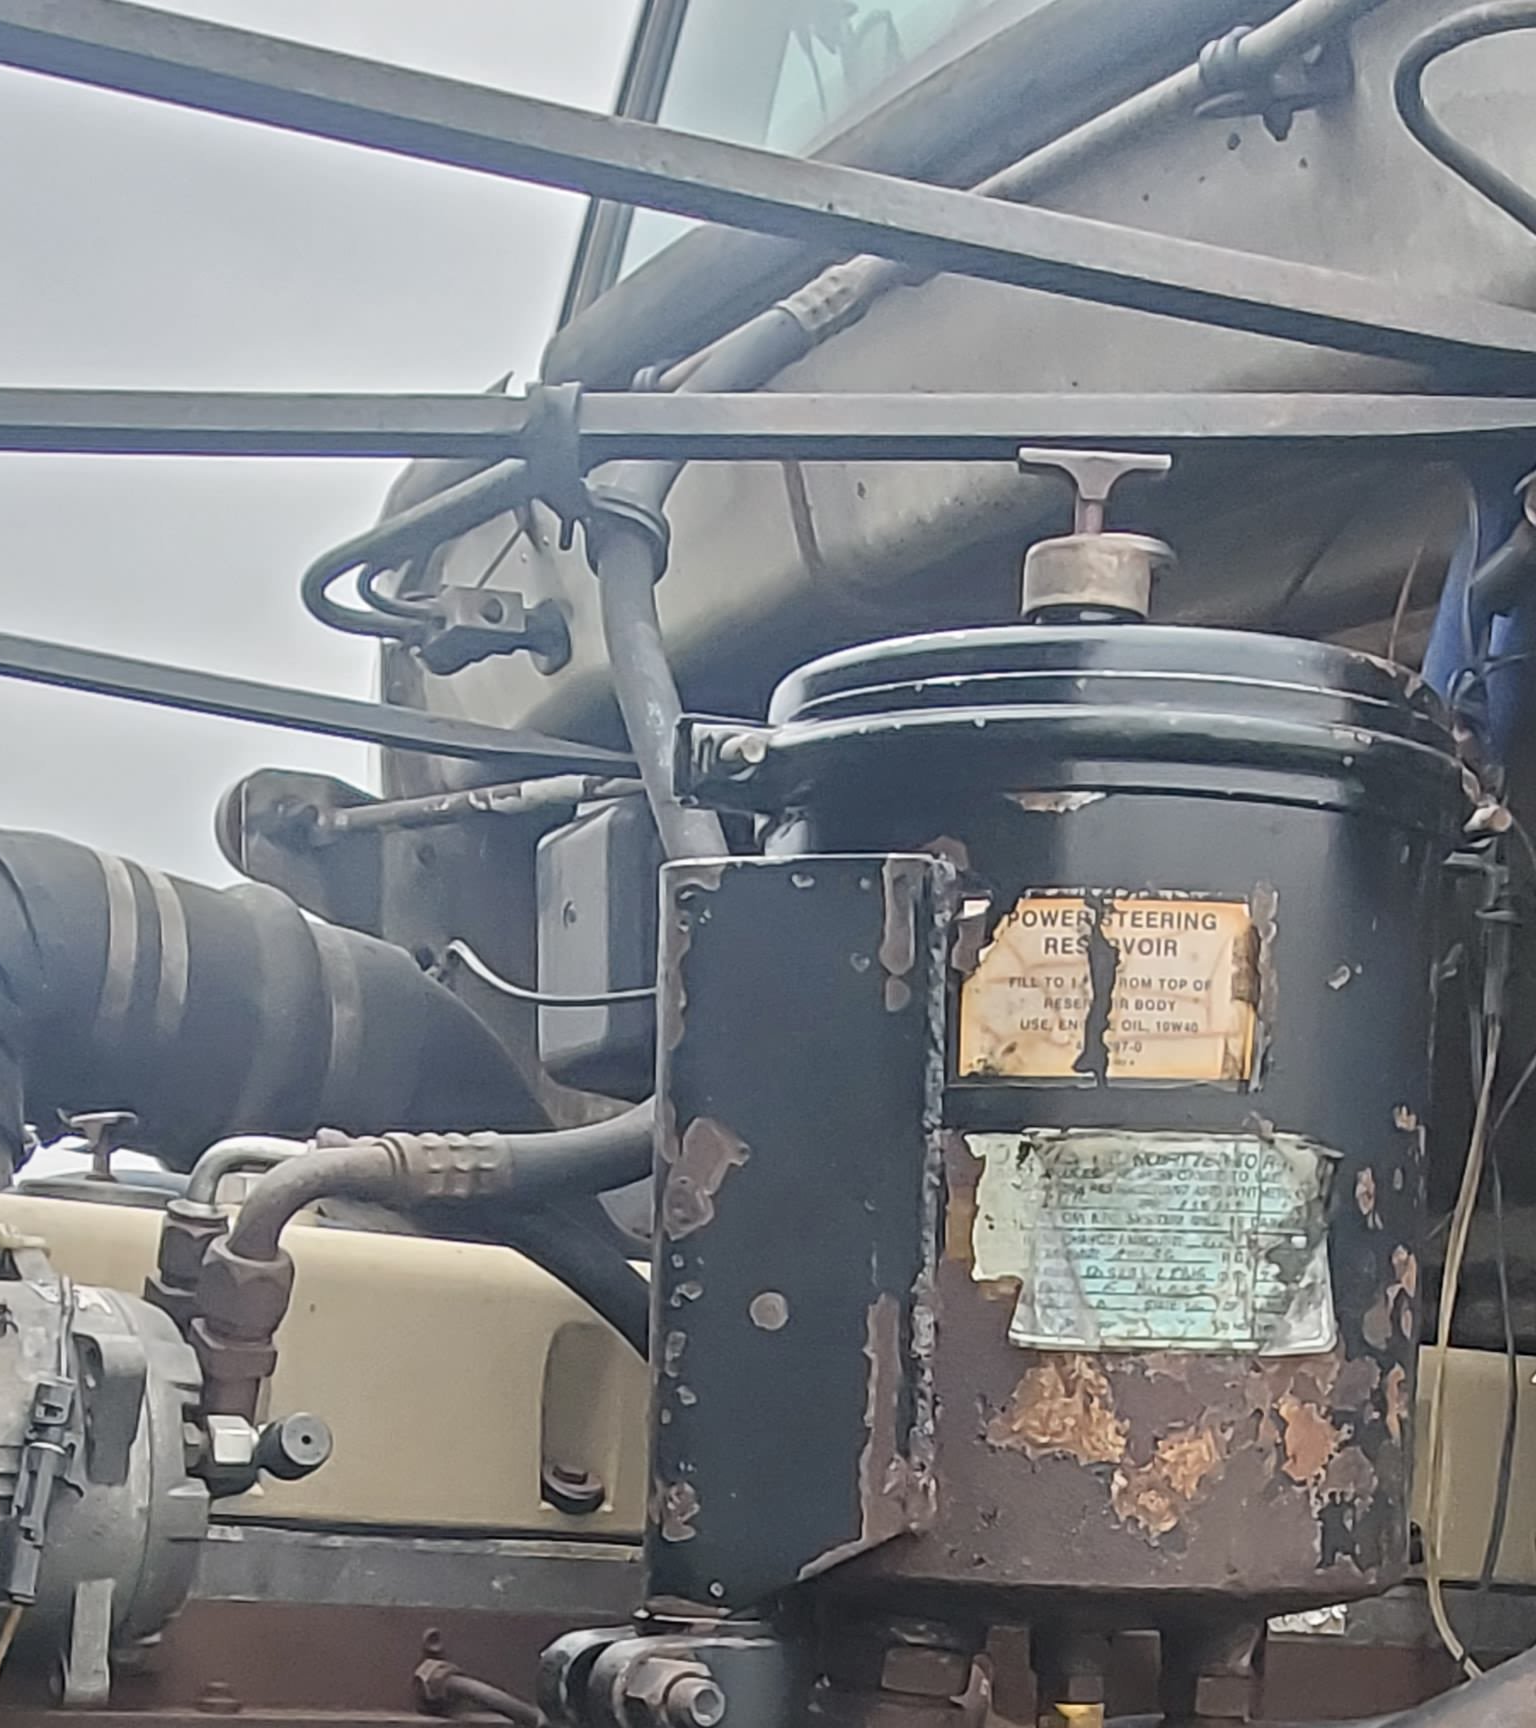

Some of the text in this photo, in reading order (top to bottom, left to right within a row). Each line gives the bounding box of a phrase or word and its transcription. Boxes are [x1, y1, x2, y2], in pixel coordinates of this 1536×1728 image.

[1006, 909, 1217, 931] POWER STEERING
[1008, 976, 1040, 989] FILL
[1045, 976, 1064, 989] TO
[1118, 977, 1153, 990] ROM
[1158, 978, 1189, 990] TOP
[1192, 979, 1212, 991] OF
[1134, 1000, 1176, 1012] BODY
